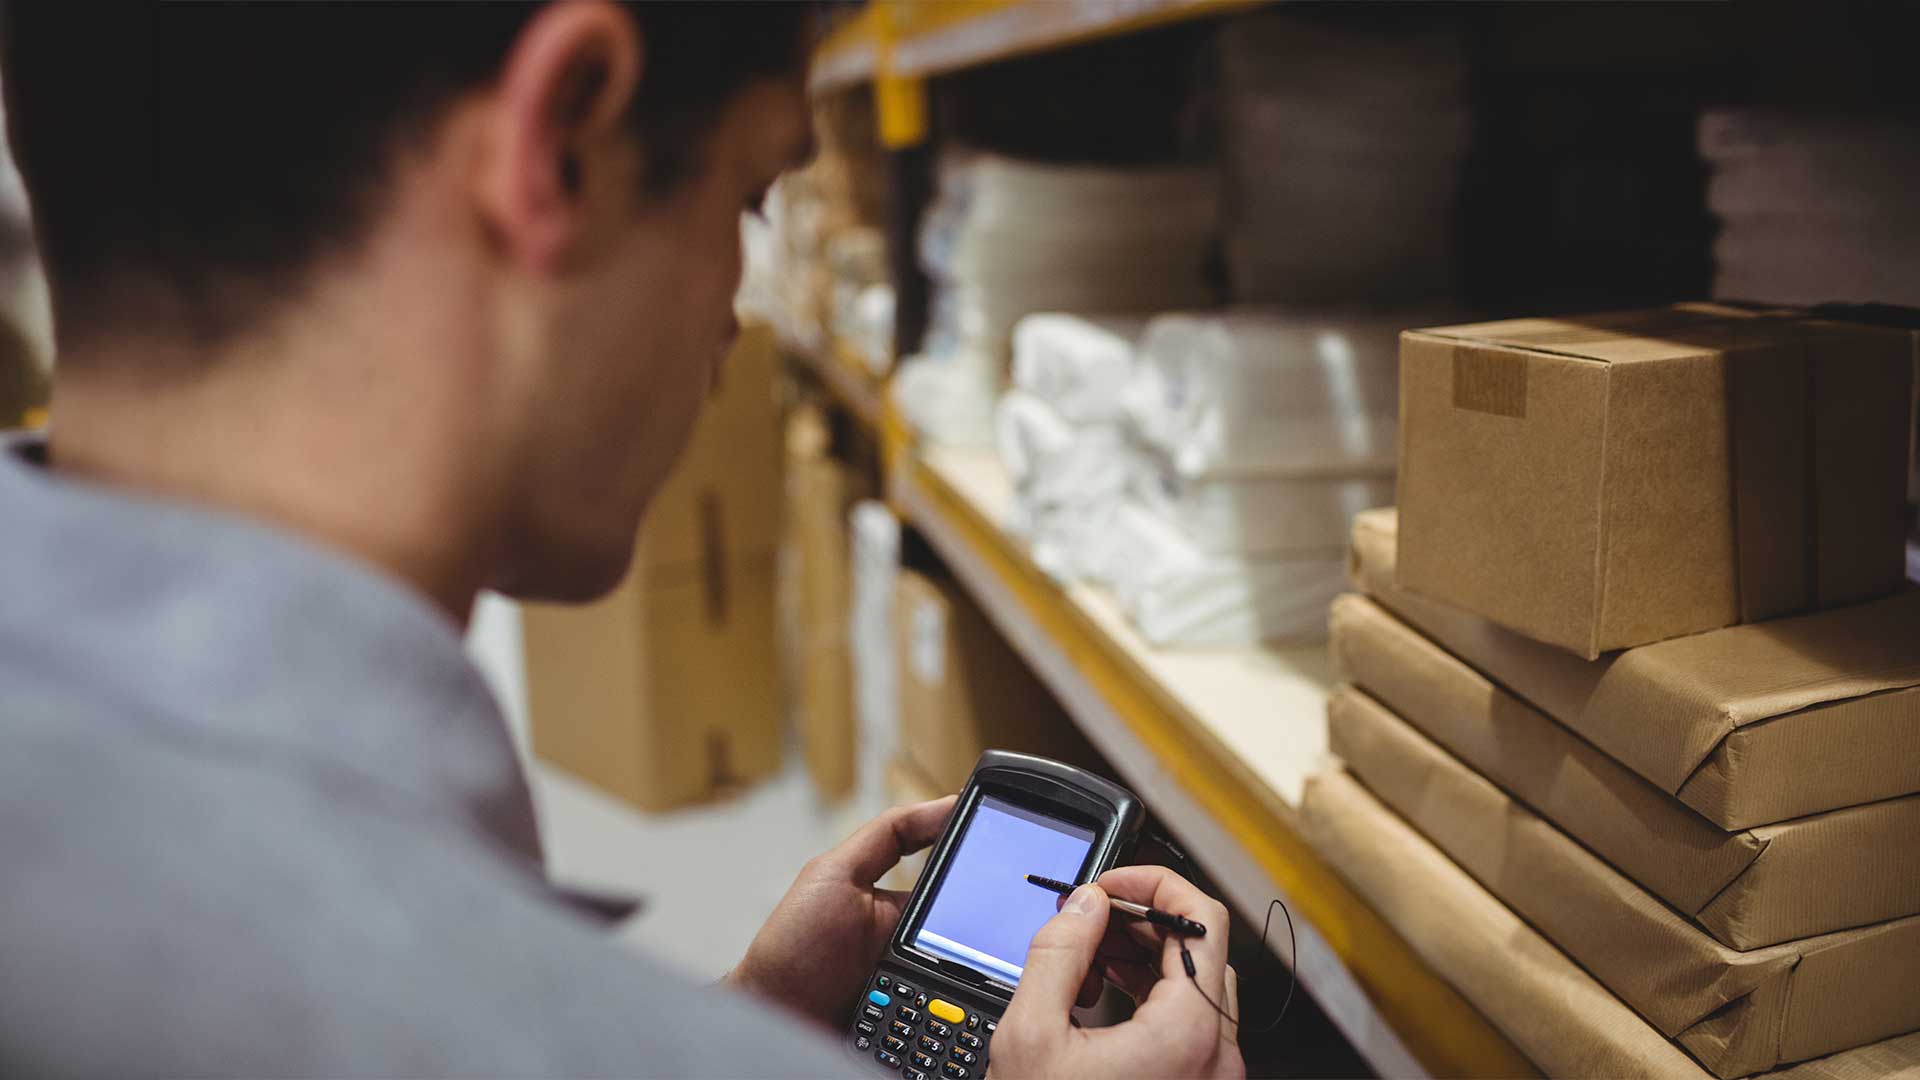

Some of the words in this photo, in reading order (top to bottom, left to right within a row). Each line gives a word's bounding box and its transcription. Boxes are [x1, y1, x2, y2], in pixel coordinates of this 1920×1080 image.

[911, 1011, 917, 1020] 1
[858, 1023, 872, 1032] SPACE
[902, 1027, 911, 1036] 4
[938, 1026, 947, 1036] 2
[896, 1040, 904, 1050] 7
[931, 1041, 940, 1051] 5
[970, 1037, 978, 1047] 3
[924, 1057, 932, 1067] 8
[964, 1053, 971, 1062] 6
[958, 1068, 966, 1078] 9
